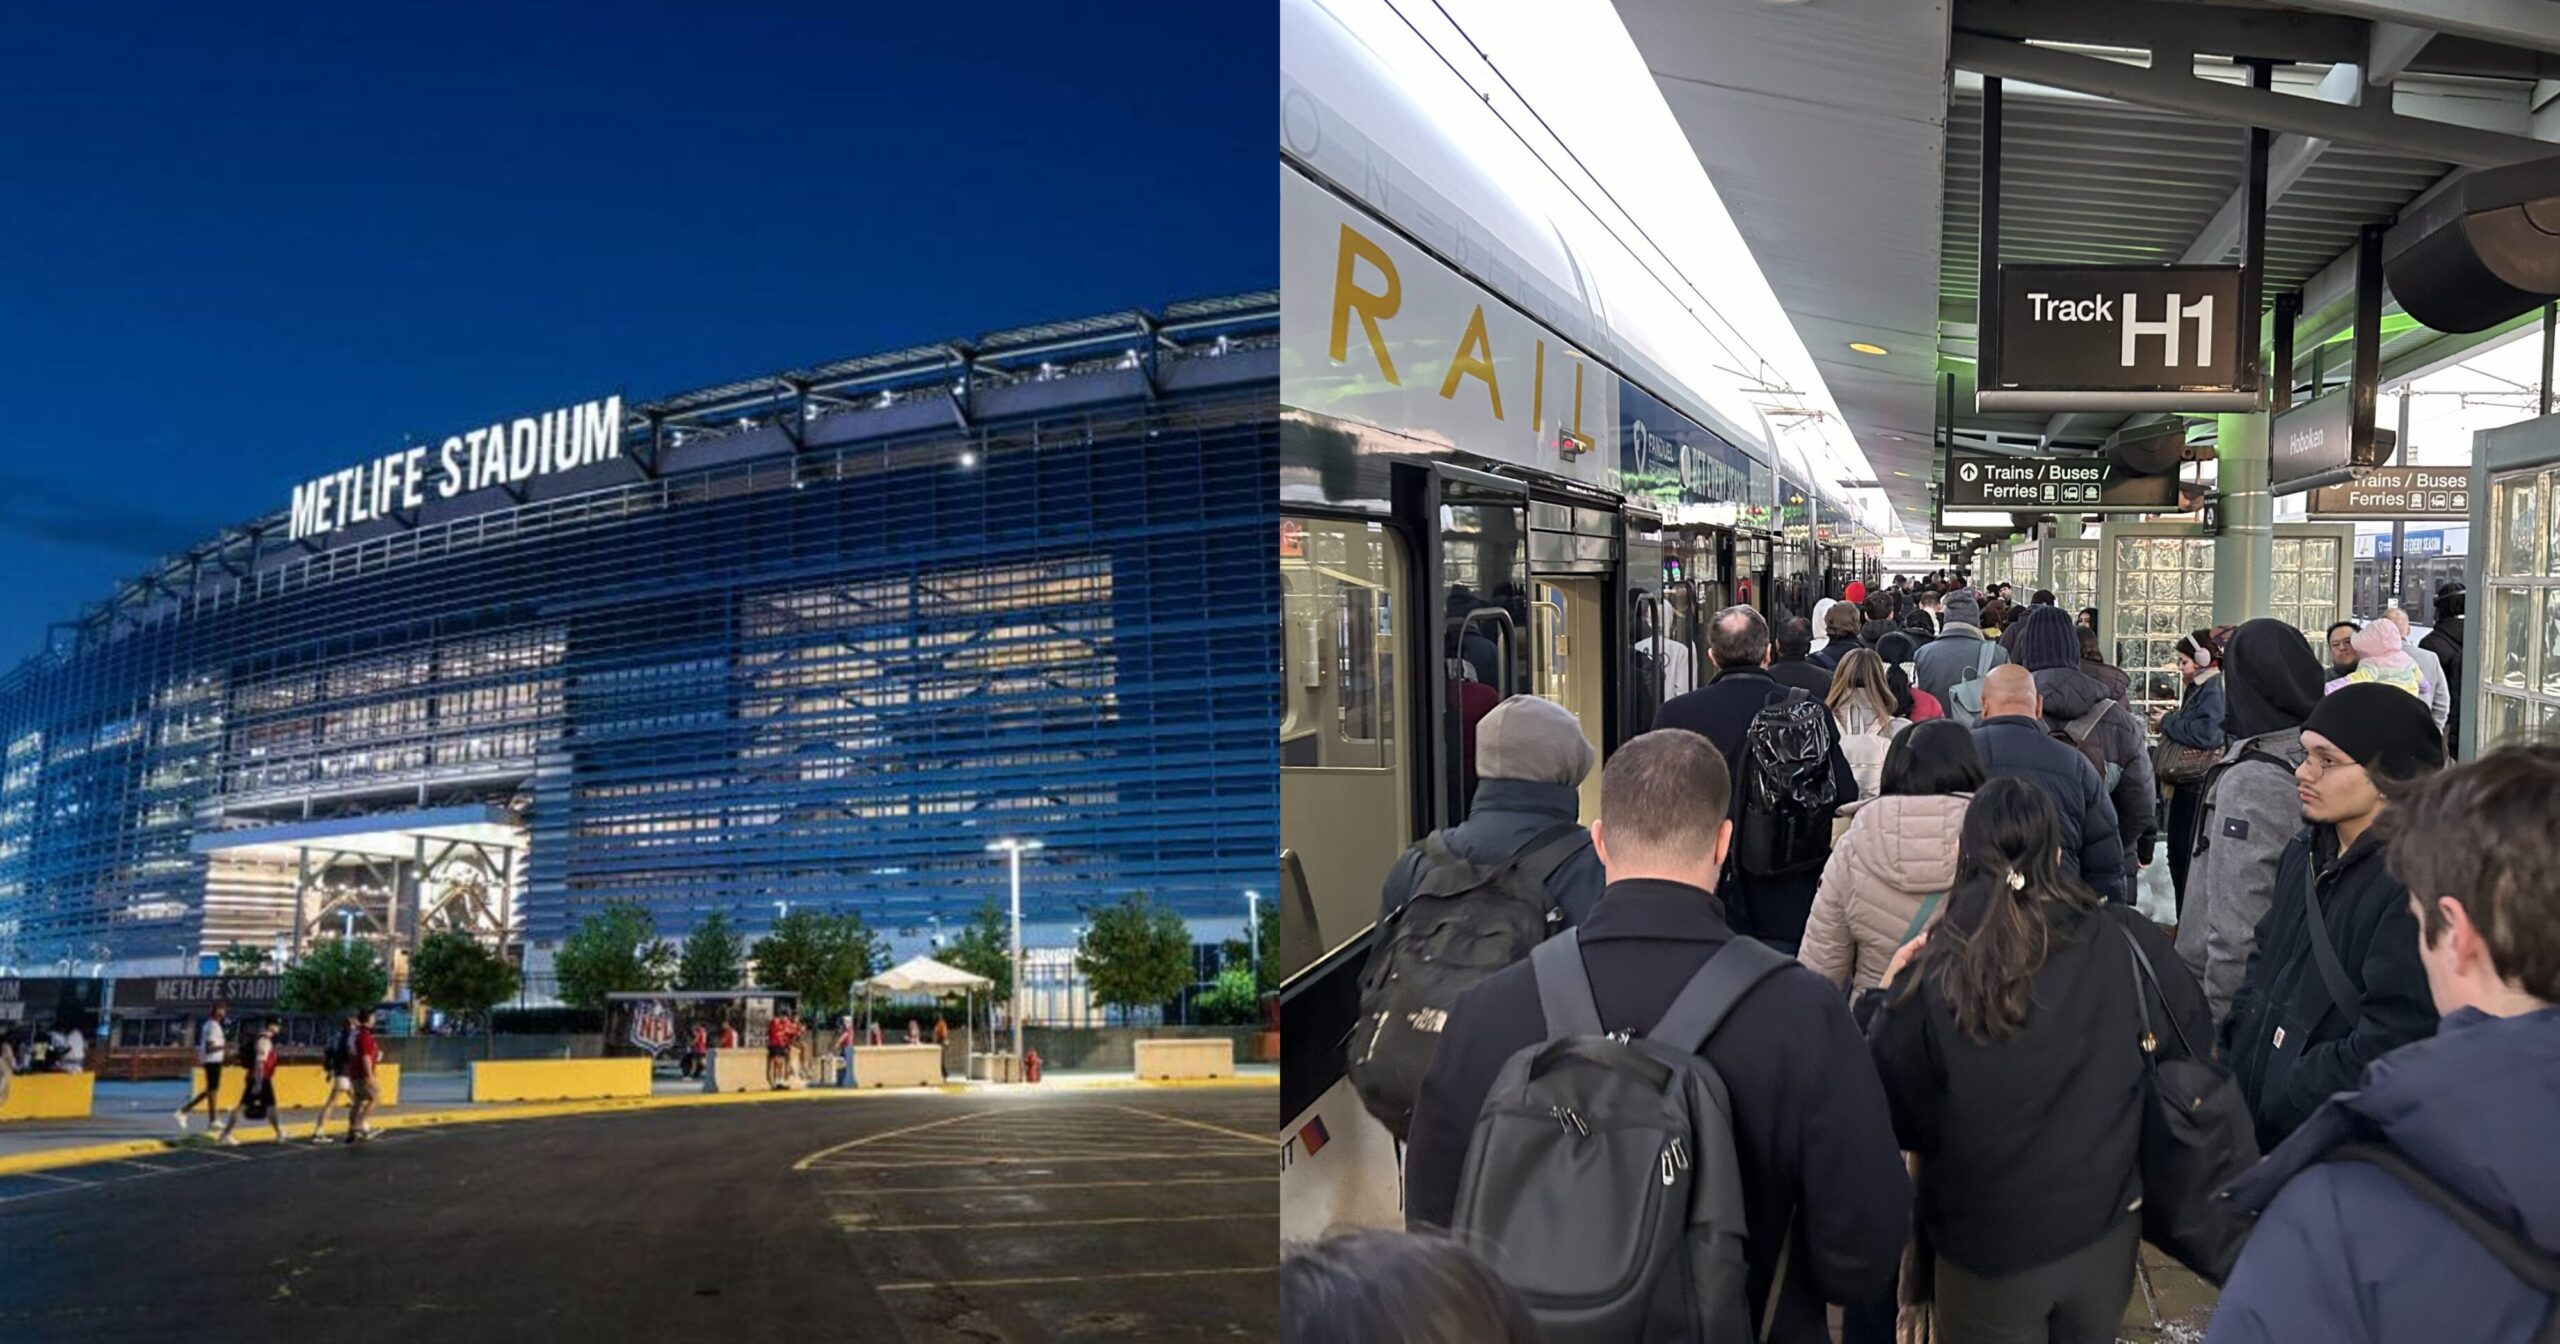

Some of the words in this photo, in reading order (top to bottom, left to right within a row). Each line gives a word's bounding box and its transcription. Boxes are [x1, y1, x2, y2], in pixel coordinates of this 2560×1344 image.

[1328, 222, 1595, 452] RAIL
[2027, 293, 2114, 322] Track
[2121, 293, 2214, 367] H1
[2290, 427, 2324, 456] Hoboken
[289, 445, 427, 542] METLIFE
[438, 394, 621, 498] STADIUM
[1984, 465, 2034, 480] Trains
[2037, 465, 2046, 480] /
[2049, 465, 2099, 480] Buses
[2102, 465, 2111, 480] /
[1983, 484, 2038, 498] Ferries
[2405, 473, 2413, 488] /
[2417, 473, 2467, 488] Buses
[2350, 492, 2405, 506] Ferries
[1946, 542, 1957, 551] H1
[155, 980, 224, 1000] METLIFE
[227, 979, 284, 999] STADIU
[640, 1014, 673, 1043] NFL
